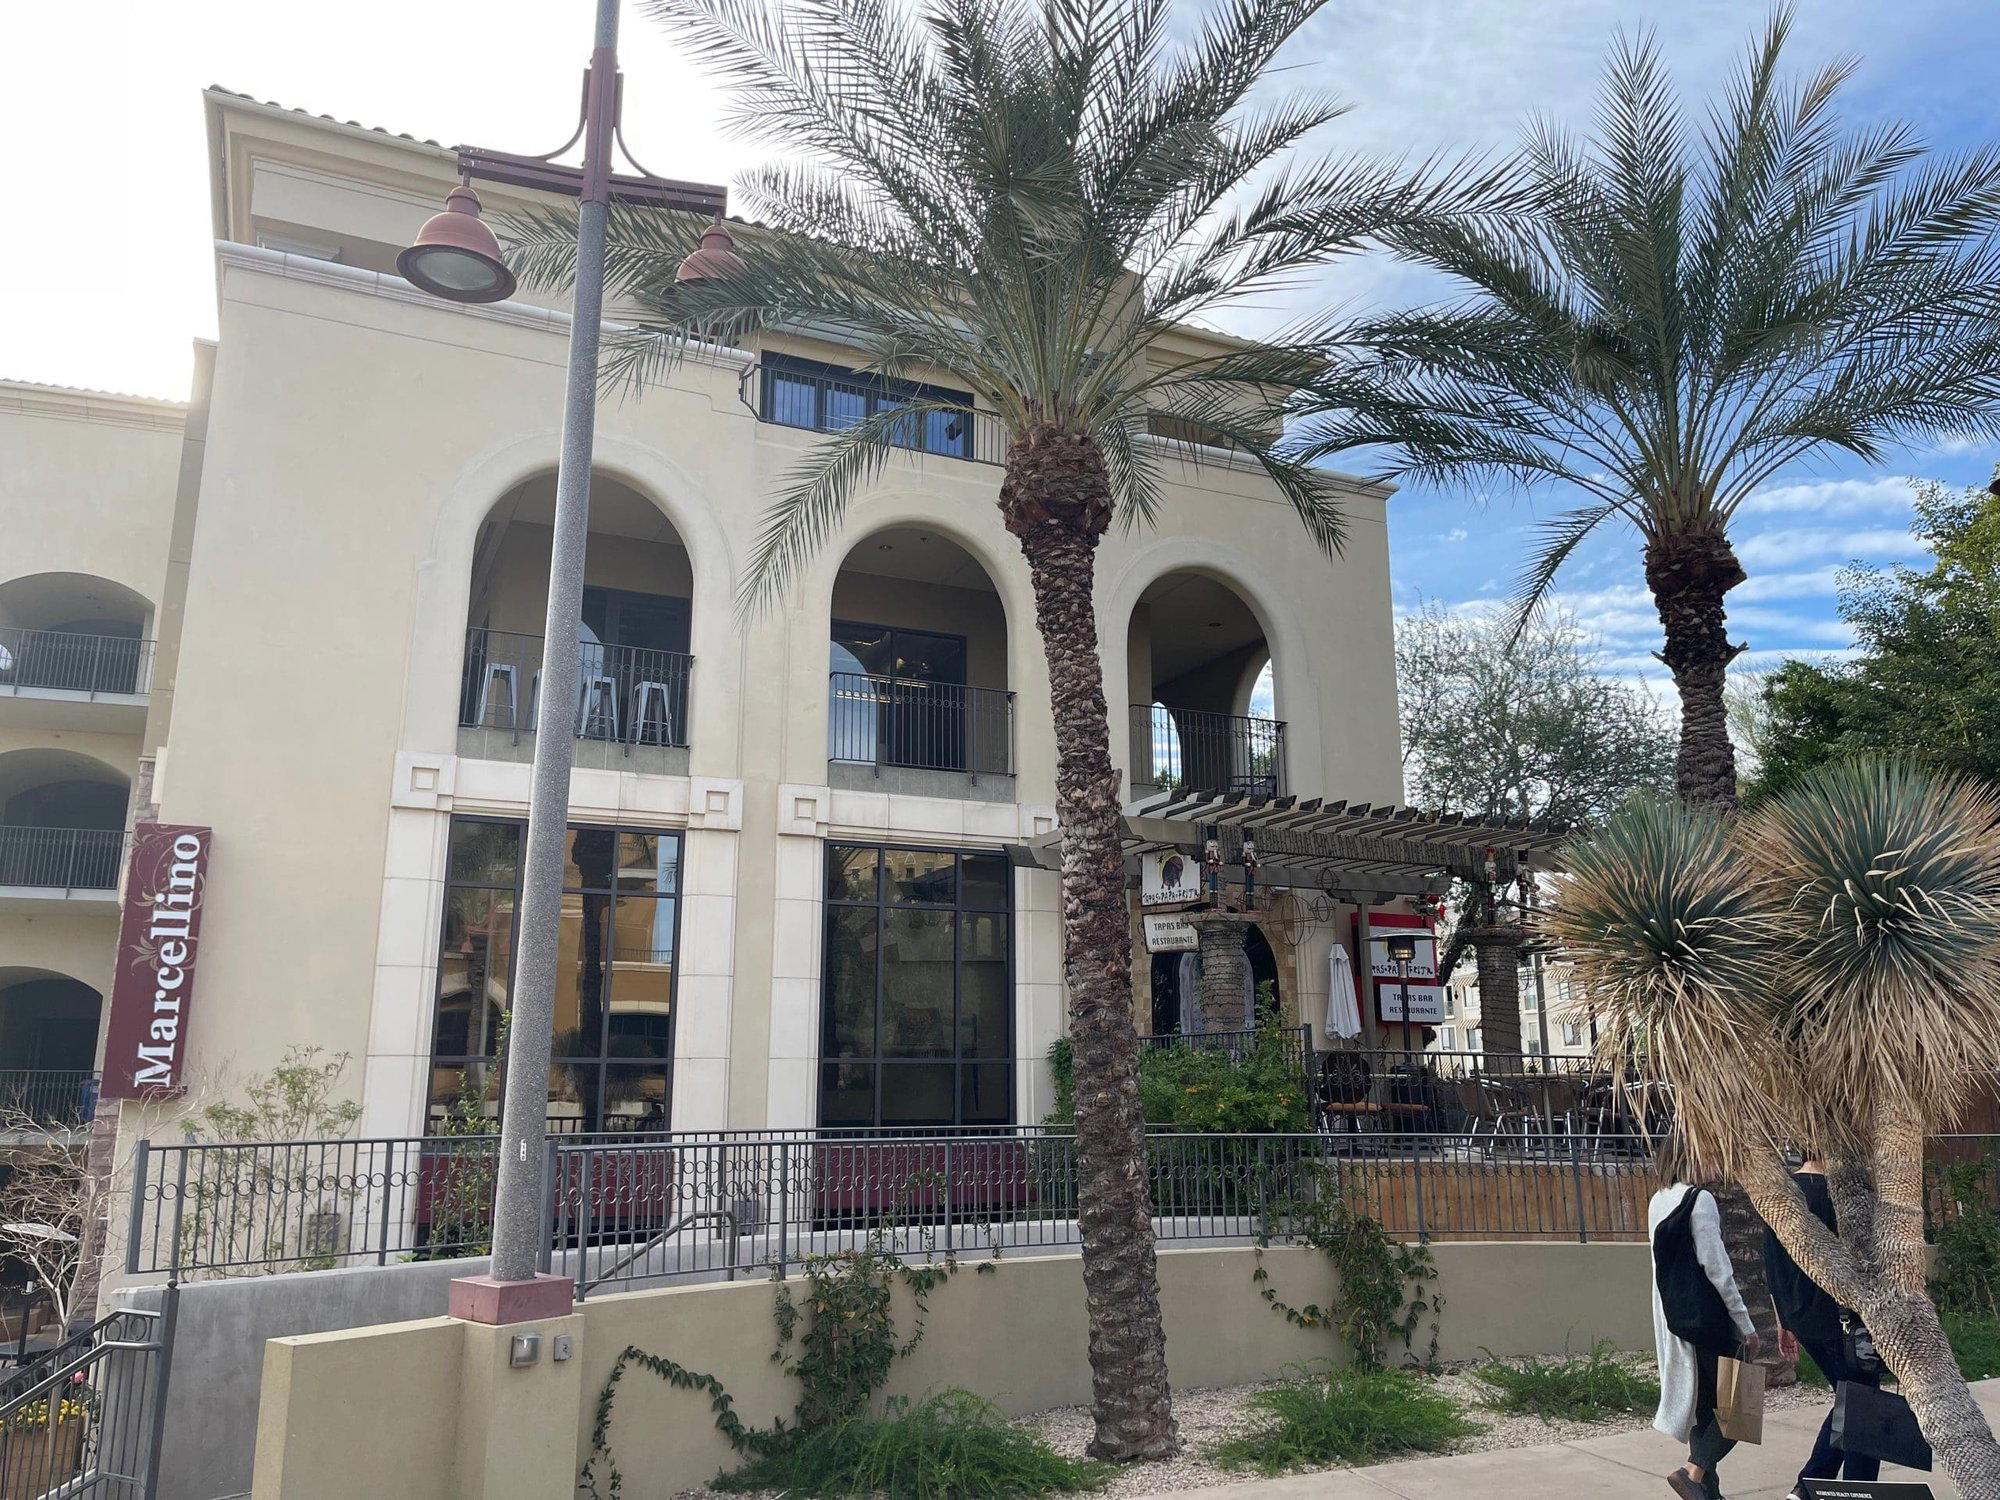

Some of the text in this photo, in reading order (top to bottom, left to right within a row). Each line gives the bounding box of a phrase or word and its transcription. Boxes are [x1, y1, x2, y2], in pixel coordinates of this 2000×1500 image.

[1153, 922, 1175, 931] TAPAS
[1152, 936, 1194, 945] RESTAURANTE
[134, 834, 201, 1088] Marcellino
[1392, 993, 1433, 1002] TAAS BAR
[1389, 1006, 1438, 1015] RESAURANTE
